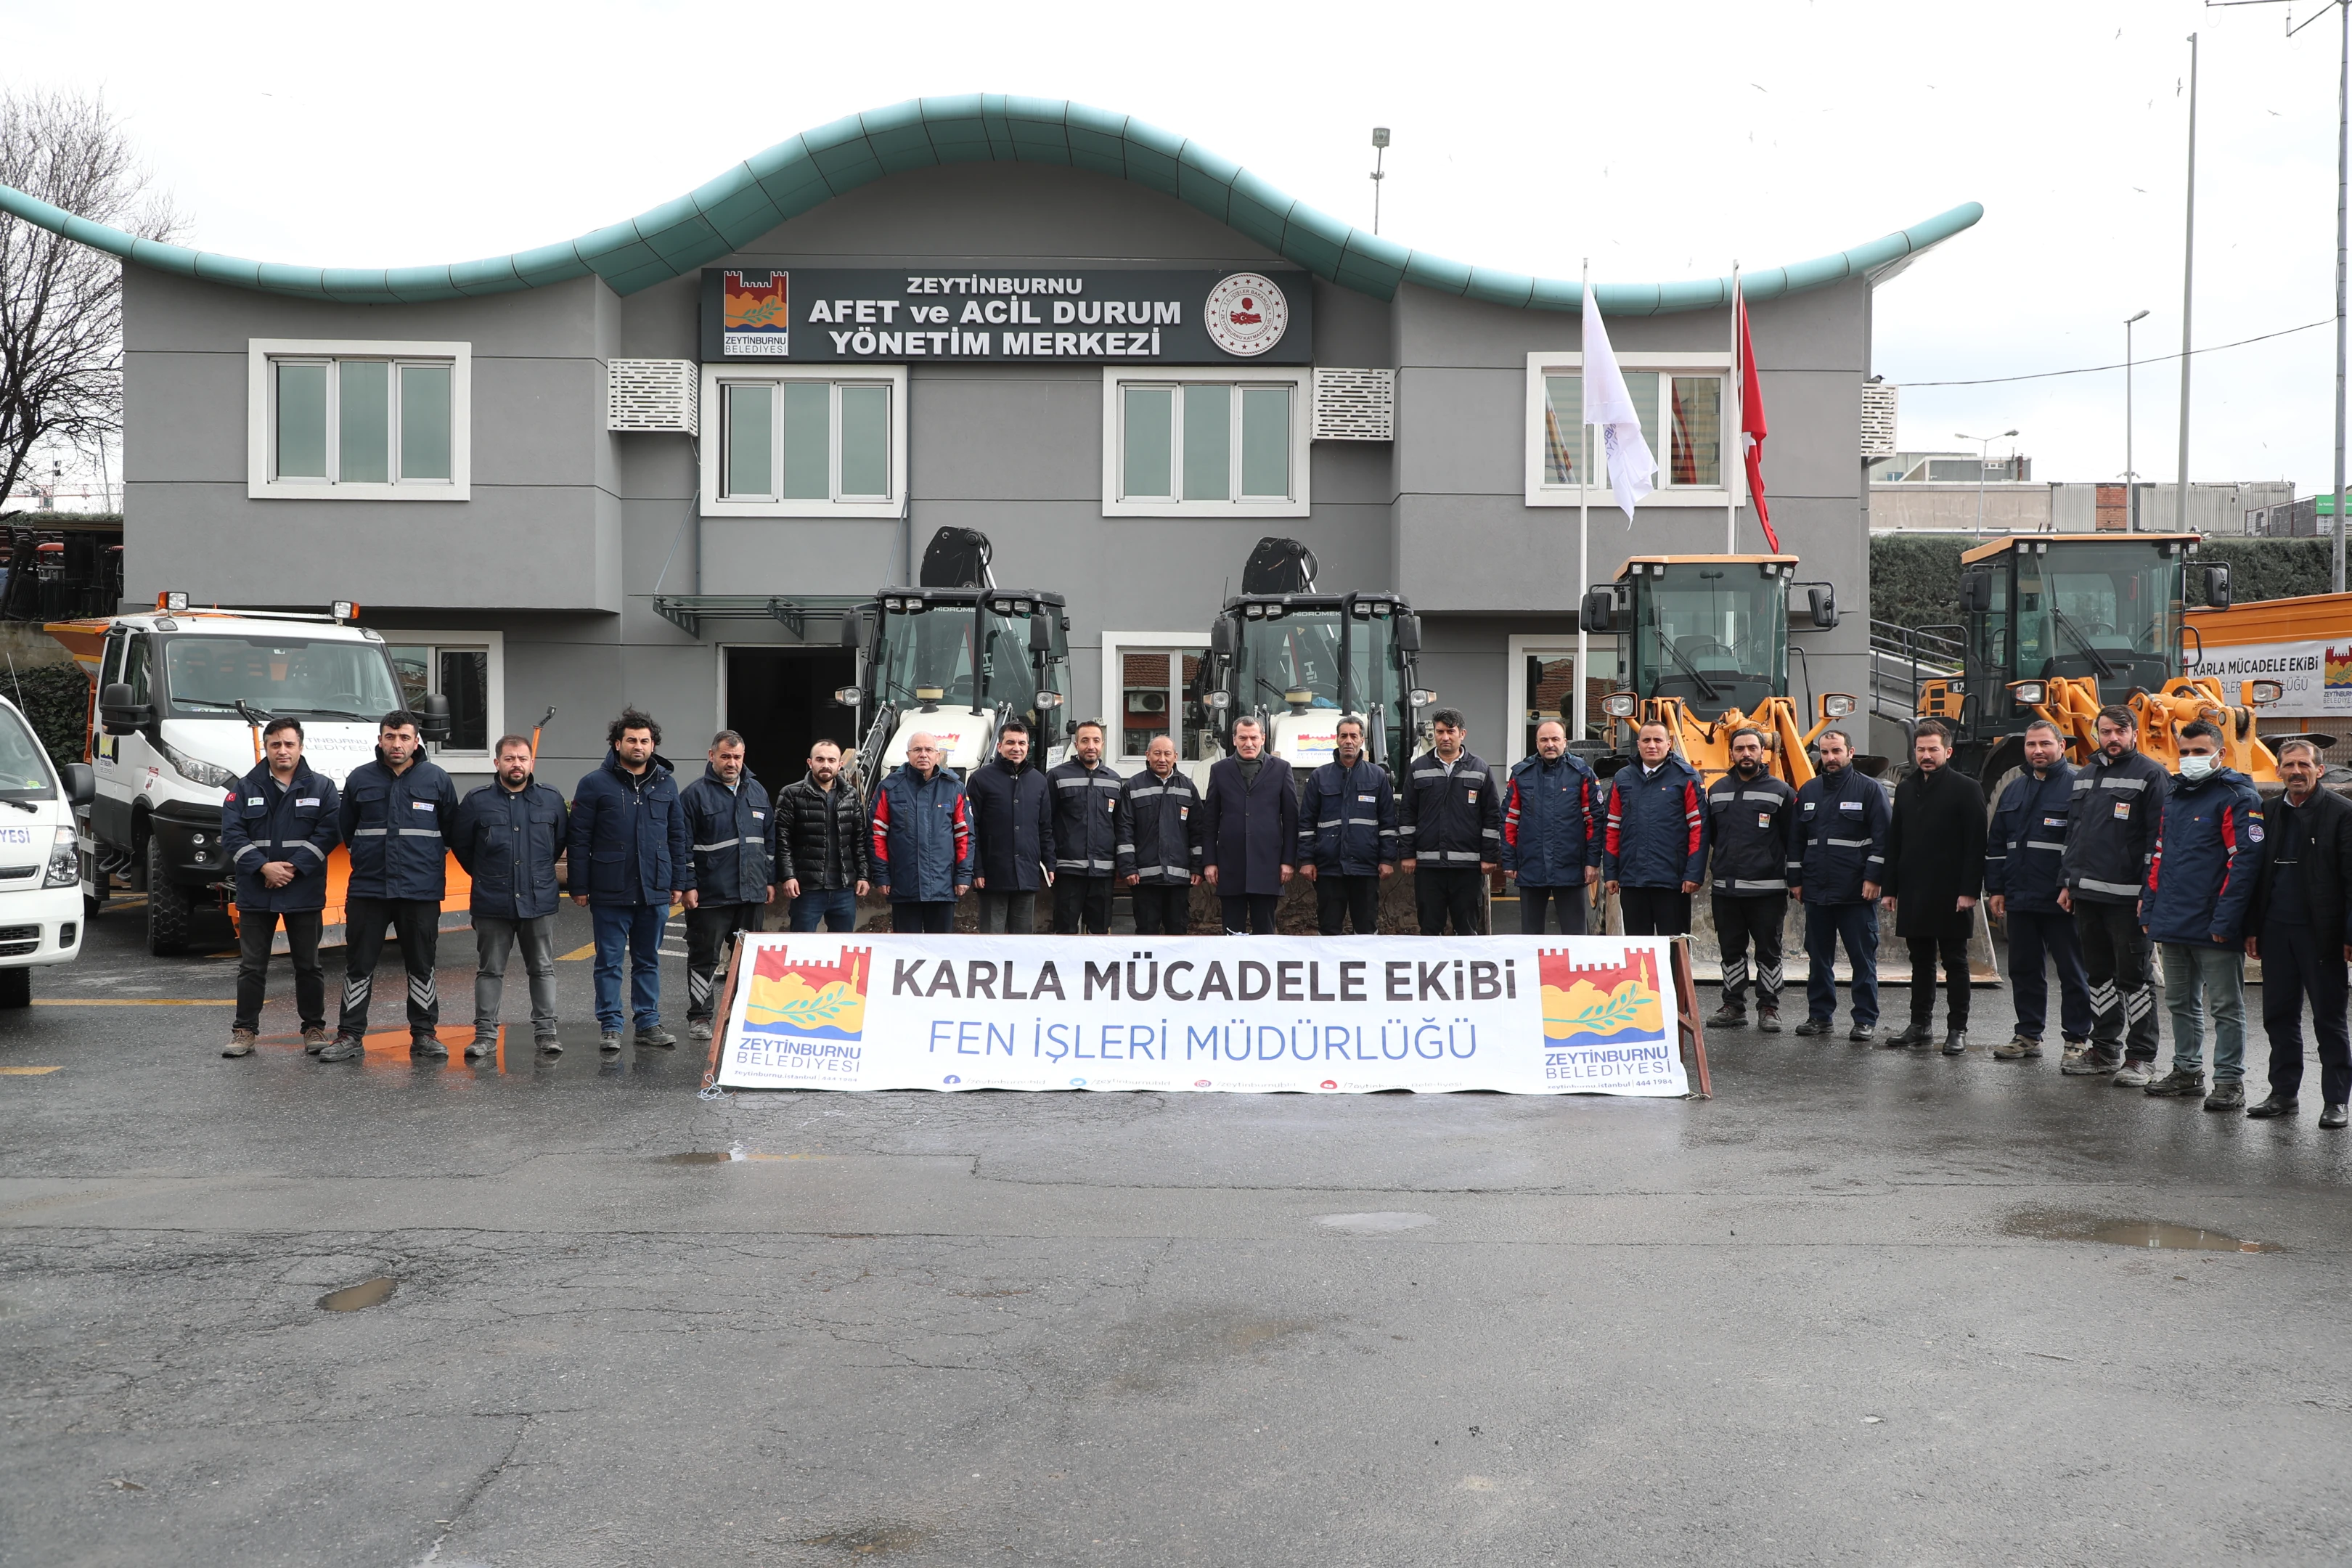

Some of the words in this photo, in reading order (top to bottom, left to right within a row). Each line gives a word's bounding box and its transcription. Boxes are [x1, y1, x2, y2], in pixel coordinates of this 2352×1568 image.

[907, 274, 1082, 295] ZEYTİNBURNU
[808, 299, 900, 324] AFET
[909, 305, 950, 324] ve
[959, 295, 1042, 324] ACİL
[1053, 301, 1181, 324] DURUM
[1220, 314, 1243, 340] ZEYTİNBURNU
[725, 335, 786, 345] ZEYTİNBURNU
[725, 345, 786, 354] BELEDİYESİ
[828, 326, 990, 356] YÖNETİM
[1003, 327, 1161, 356] MERKEZİ
[2193, 661, 2226, 677] KARLA
[2228, 658, 2287, 676] MÜCADELE
[303, 743, 372, 752] LEDİYESİ
[305, 736, 368, 745] TİNBURNU
[892, 958, 1066, 1001] KARLA
[1083, 951, 1366, 1002] MÜCADELE
[739, 1037, 862, 1059] ZEYTİNBURNU
[928, 1019, 1014, 1057] FEN
[1033, 1016, 1167, 1063] İŞLERİ
[1186, 1017, 1477, 1061] MÜDÜRLÜĞÜ
[736, 1051, 860, 1073] BELEDİYESİ
[1544, 1045, 1669, 1066] ZEYTİNBURNU
[1545, 1058, 1671, 1079] BELEDİYESİ
